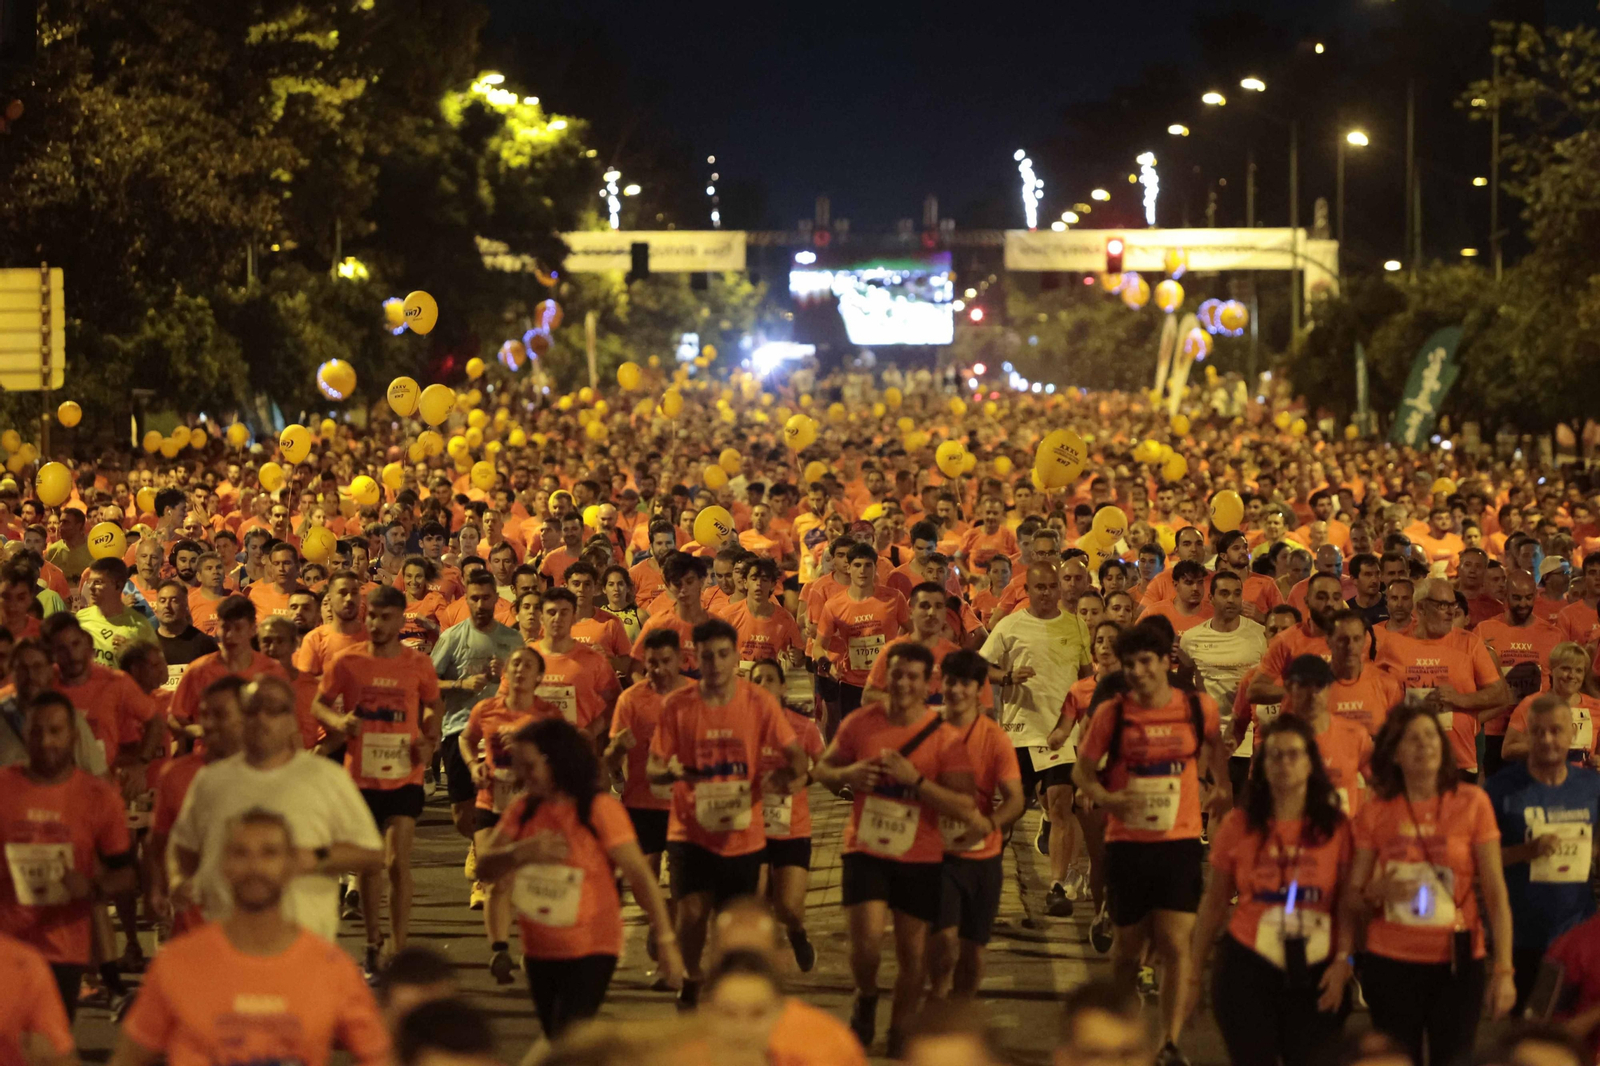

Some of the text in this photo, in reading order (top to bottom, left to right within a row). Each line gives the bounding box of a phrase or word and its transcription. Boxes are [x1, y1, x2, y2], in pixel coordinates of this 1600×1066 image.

[1060, 443, 1079, 457] XXXV
[1056, 457, 1071, 467] KH7
[713, 521, 728, 534] KH7
[855, 613, 874, 623] XXXV
[750, 634, 770, 643] XXXV
[1510, 642, 1533, 650] XXXV
[856, 647, 880, 656] 17076
[1415, 658, 1440, 666] XXXV
[1337, 701, 1363, 711] XXXV
